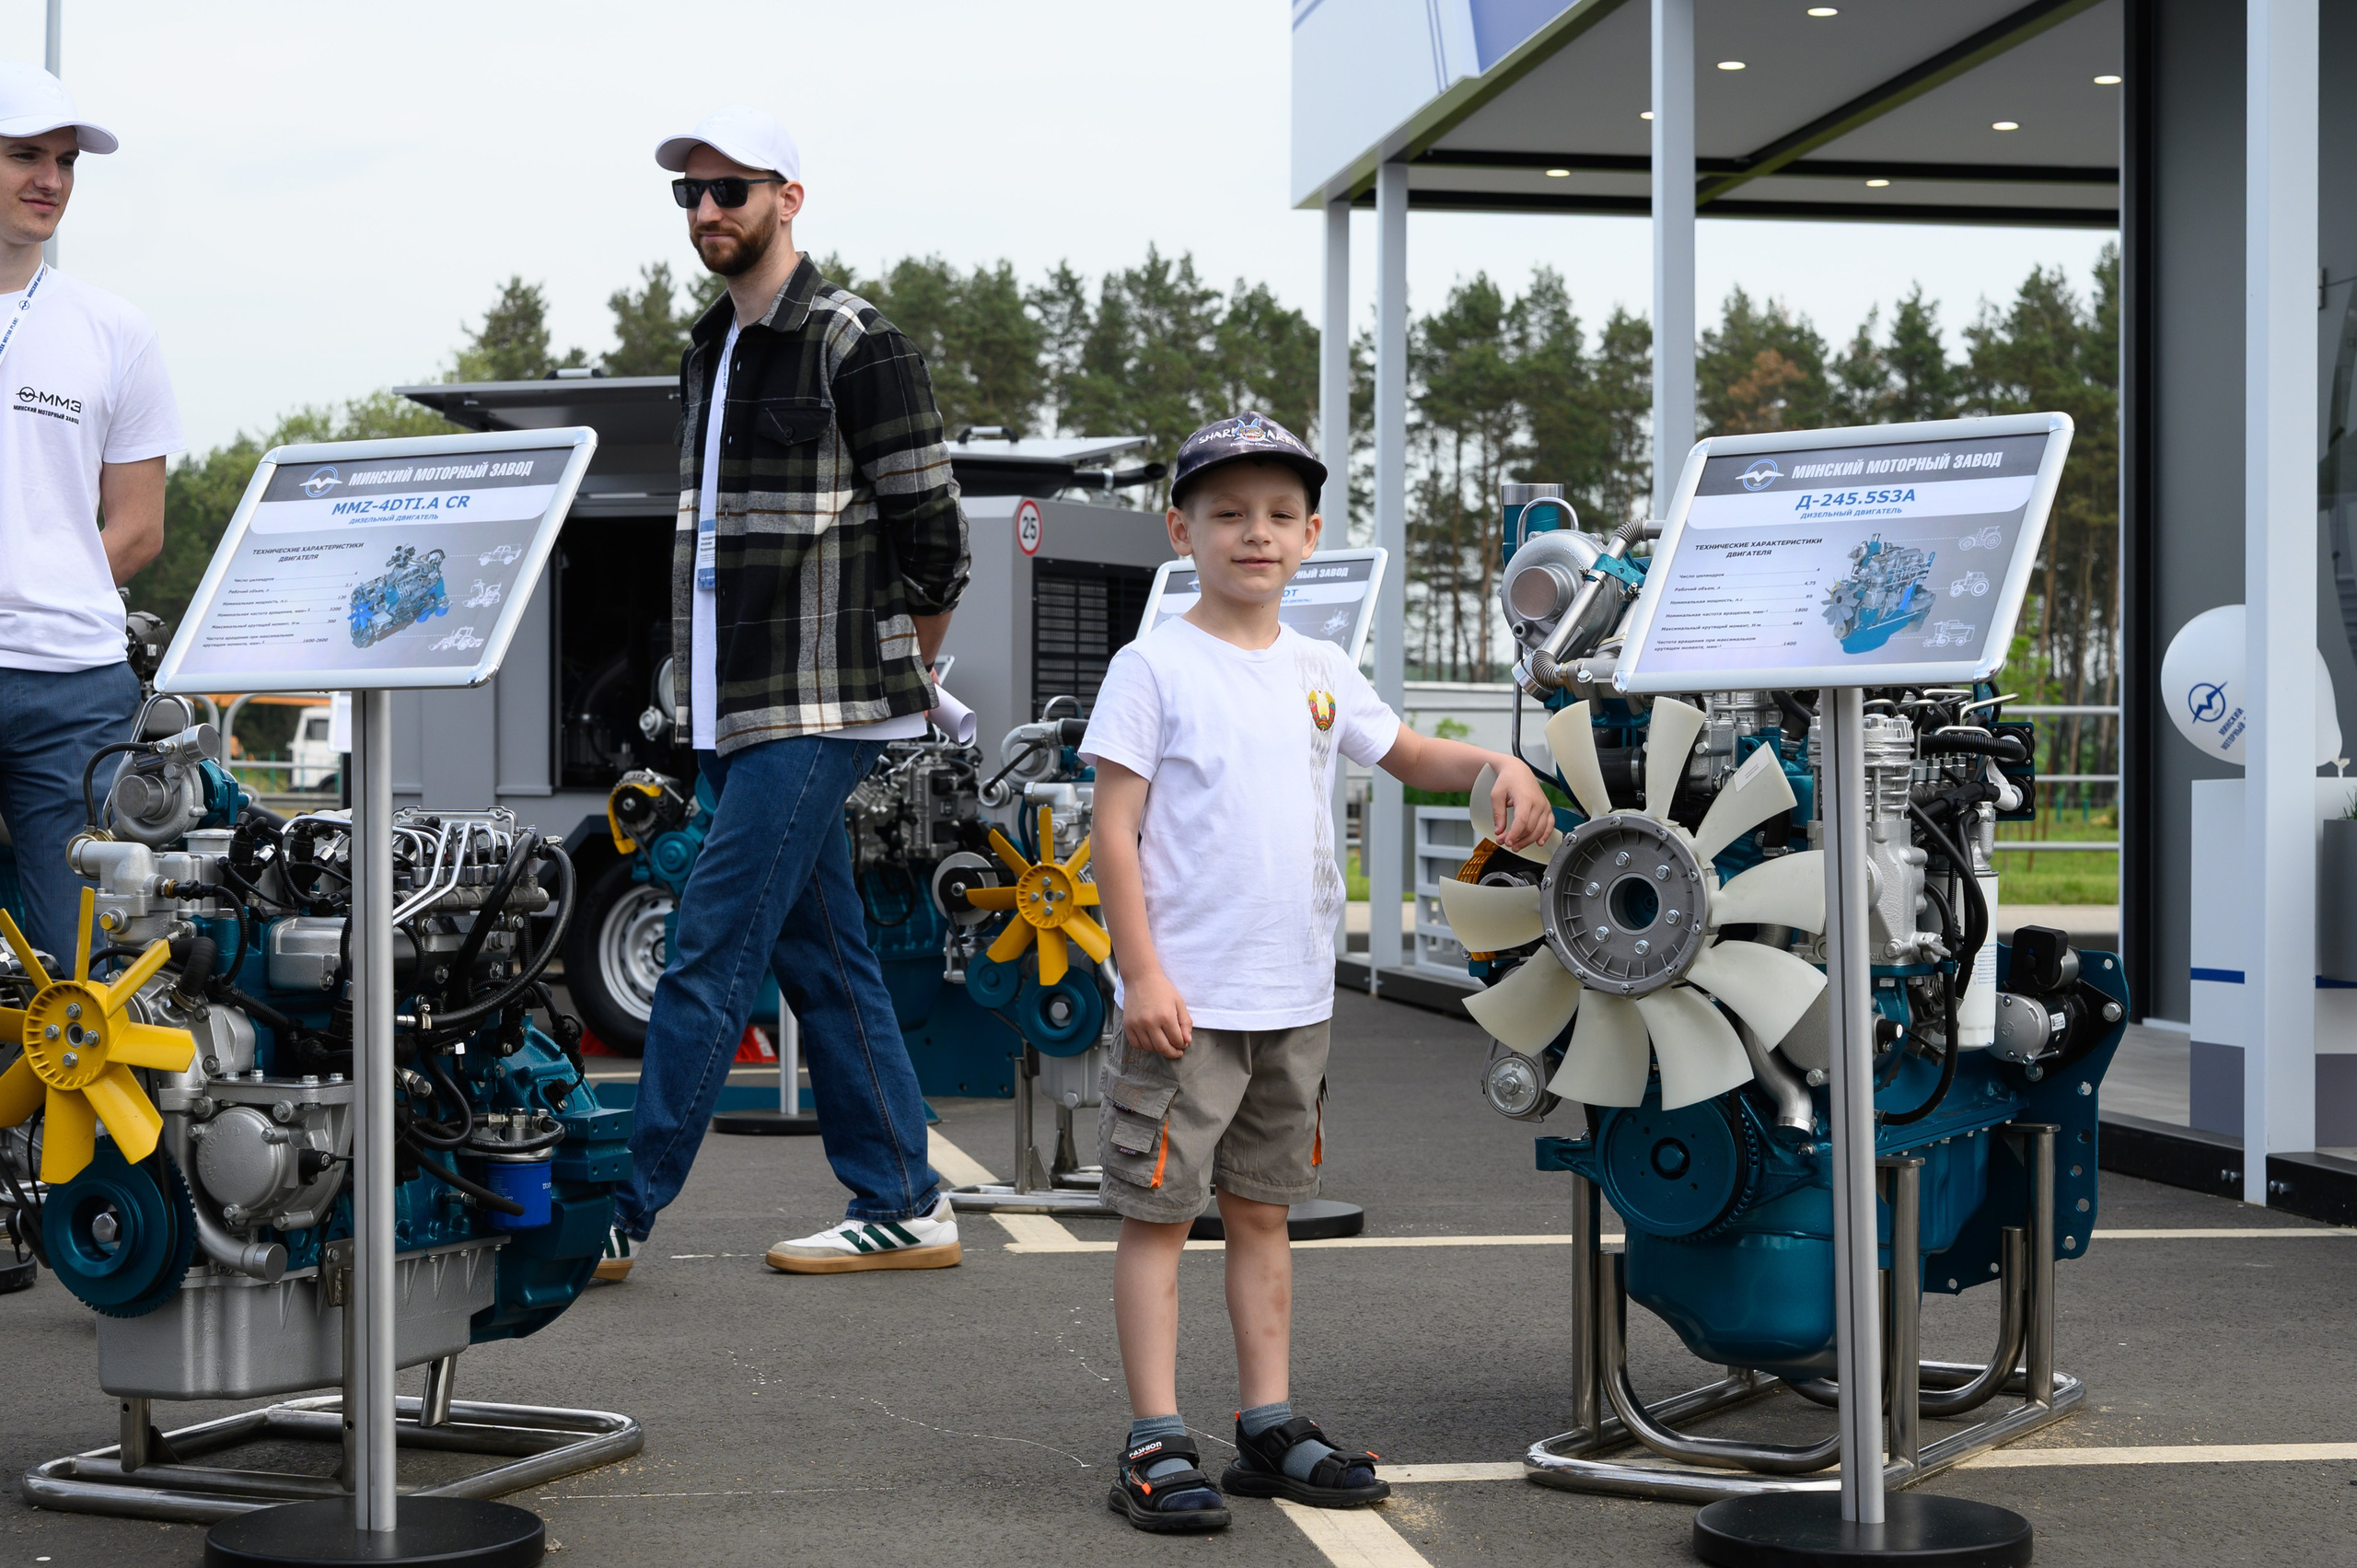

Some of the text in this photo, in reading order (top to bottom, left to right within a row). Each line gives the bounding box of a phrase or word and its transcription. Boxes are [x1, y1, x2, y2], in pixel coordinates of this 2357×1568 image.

[13, 405, 79, 424] МИНСКИЙ МОТОРНЫЙ ЗАВОД
[348, 461, 534, 486] МИНСКИЙ МОТОРНЫЙ ЗАВОД
[1791, 452, 2003, 479] МИНСКИЙ МОТОРНЫЙ ЗАВОД
[331, 496, 470, 515] MMZ-4DTI.A CR
[1800, 508, 1902, 519] ДИЗЕЛЬНЫЙ ДВИГАТЕЛЬ
[348, 515, 394, 525] ДИЗЕЛЬНЫЙ
[1022, 516, 1037, 540] 25
[253, 542, 364, 555] ТЕХНИЧЕСКИЕ ХАРАКТЕРИСТИКИ
[1695, 538, 1822, 550] ТЕХНИЧЕСКИЕ ХАРАКТЕРИСТИКИ
[278, 554, 319, 563] ДВИГАТЕЛЯ
[1726, 549, 1772, 558] ДВИГАТЕЛЯ
[1318, 567, 1349, 578] ЗАВОД
[2218, 707, 2244, 736] МИНСКИЙ
[2220, 721, 2246, 750] МОТОРНЫЙ
[1129, 1441, 1162, 1458] FASHION
